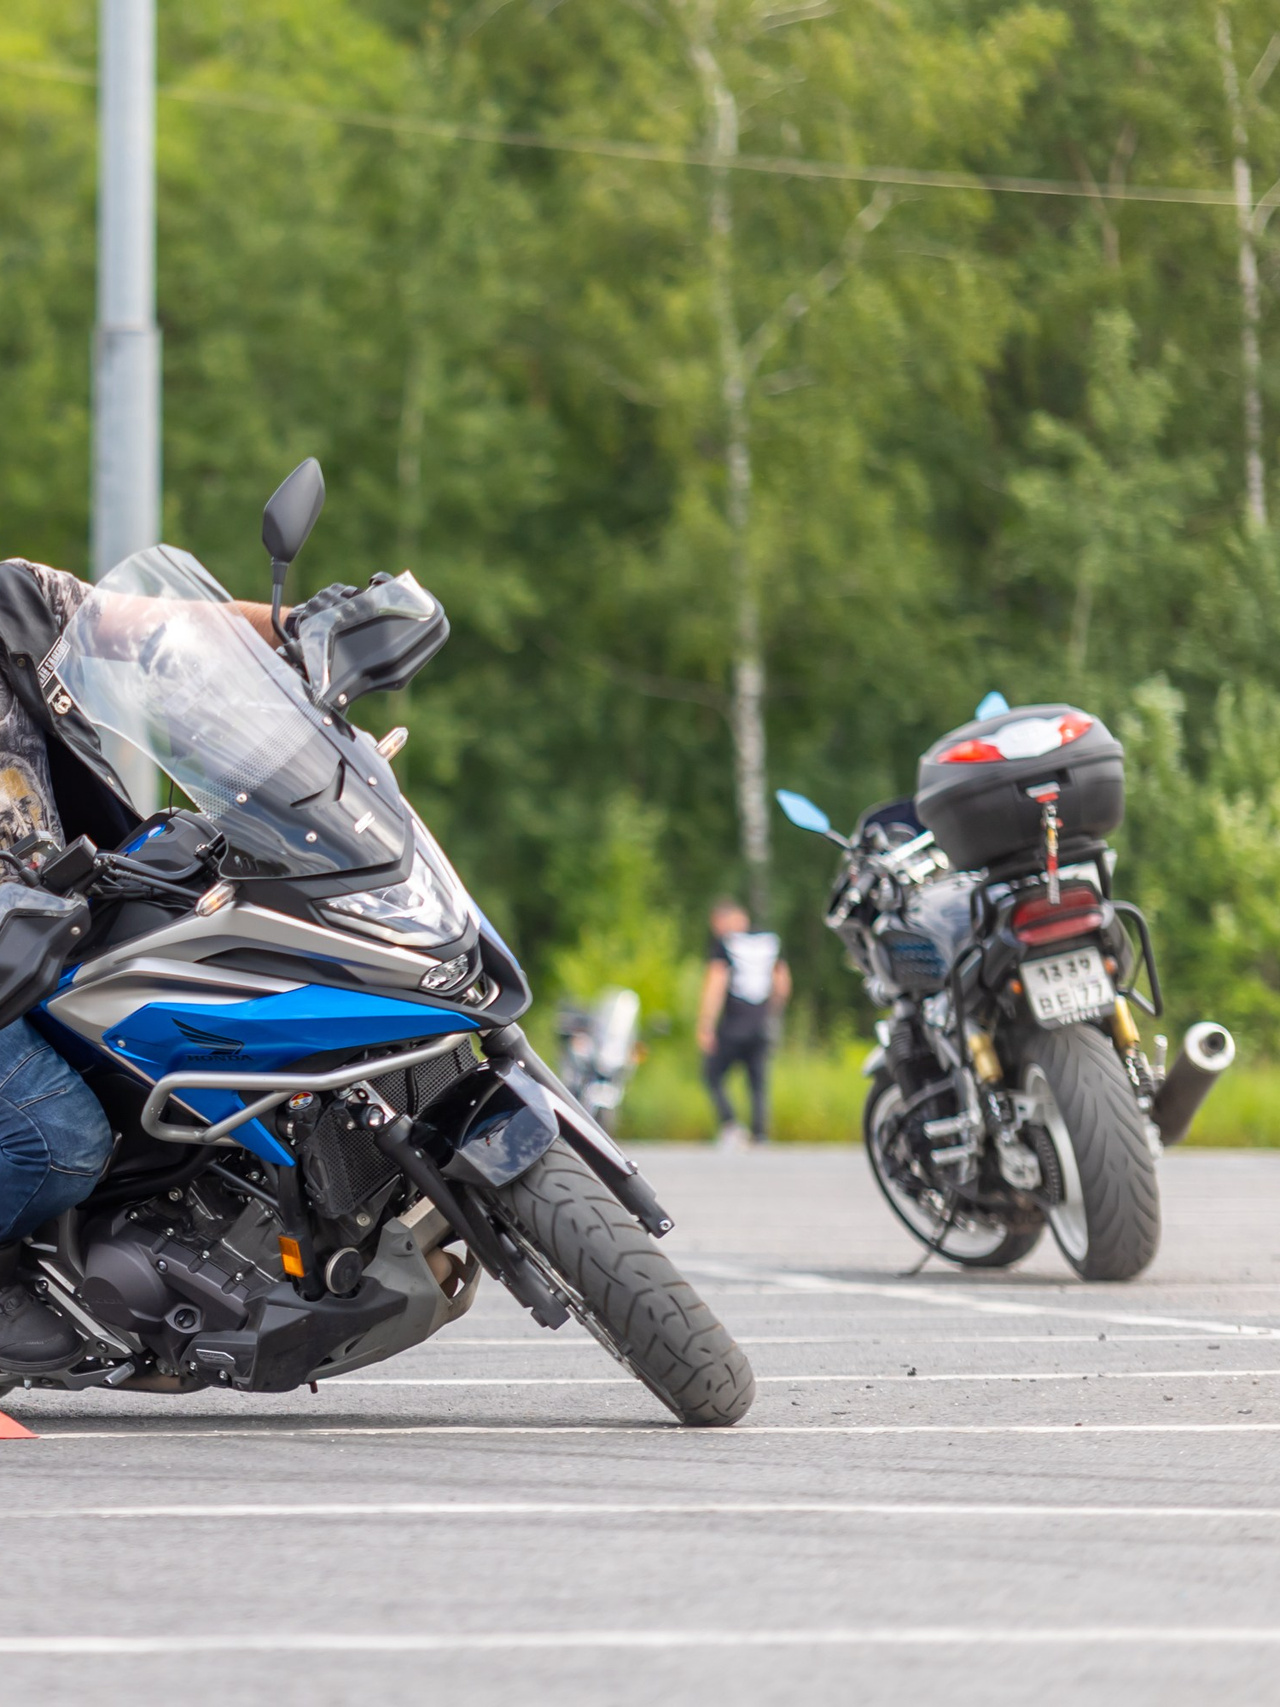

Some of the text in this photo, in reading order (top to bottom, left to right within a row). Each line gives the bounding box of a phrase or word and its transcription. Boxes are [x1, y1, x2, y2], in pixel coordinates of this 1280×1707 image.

[1038, 957, 1091, 985] 1339
[1080, 982, 1103, 1007] 77
[186, 1054, 254, 1062] HONDA
